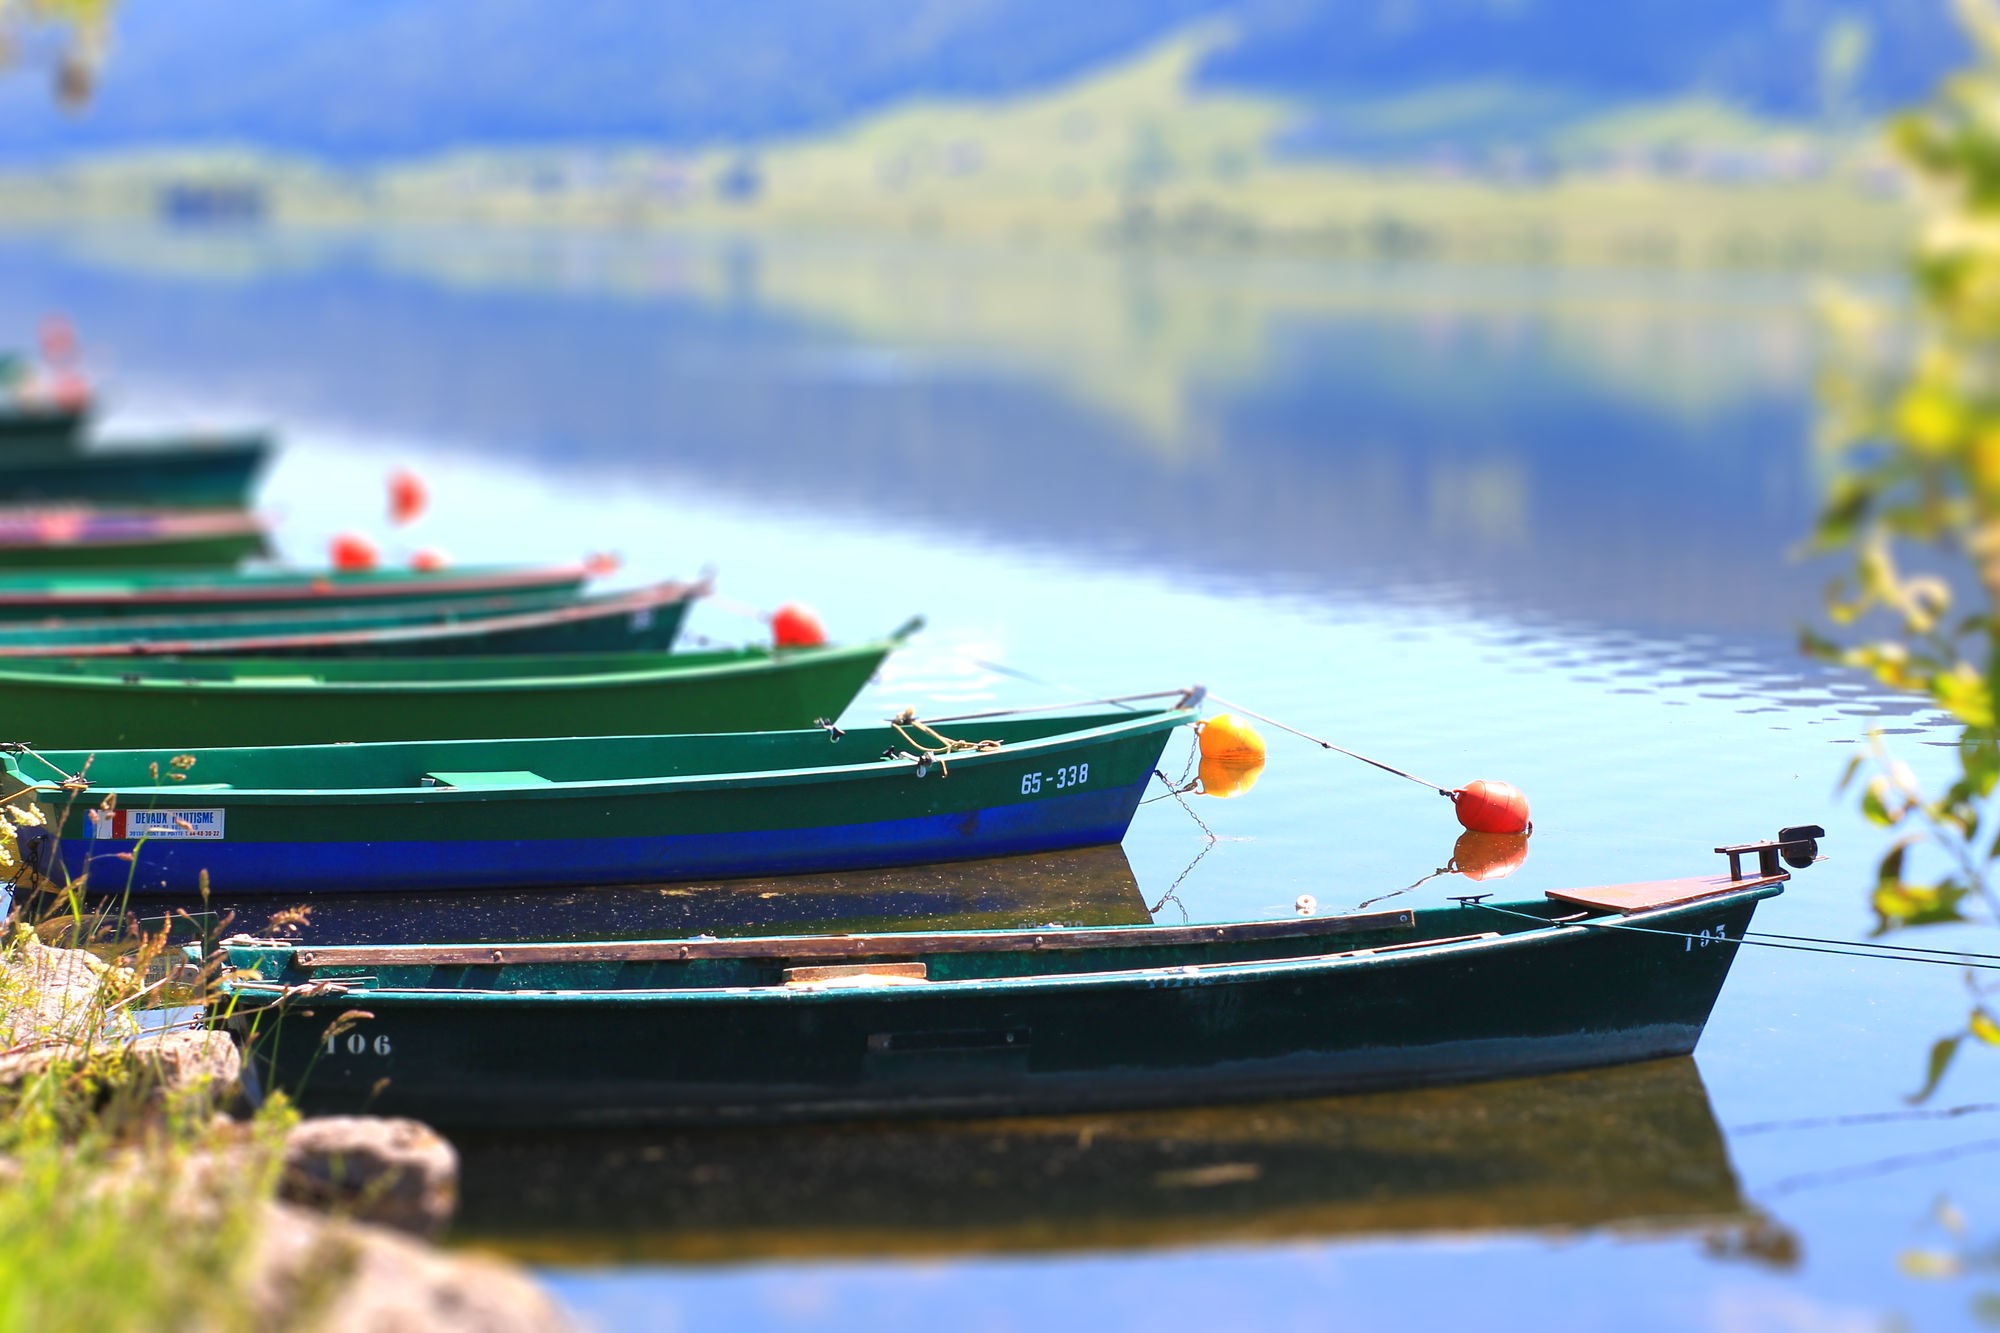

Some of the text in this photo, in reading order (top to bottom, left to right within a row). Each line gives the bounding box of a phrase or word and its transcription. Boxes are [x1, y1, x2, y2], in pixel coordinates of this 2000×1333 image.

[1021, 763, 1089, 795] 65-338
[135, 812, 168, 824] DEVAUX
[325, 1033, 392, 1056] 106
